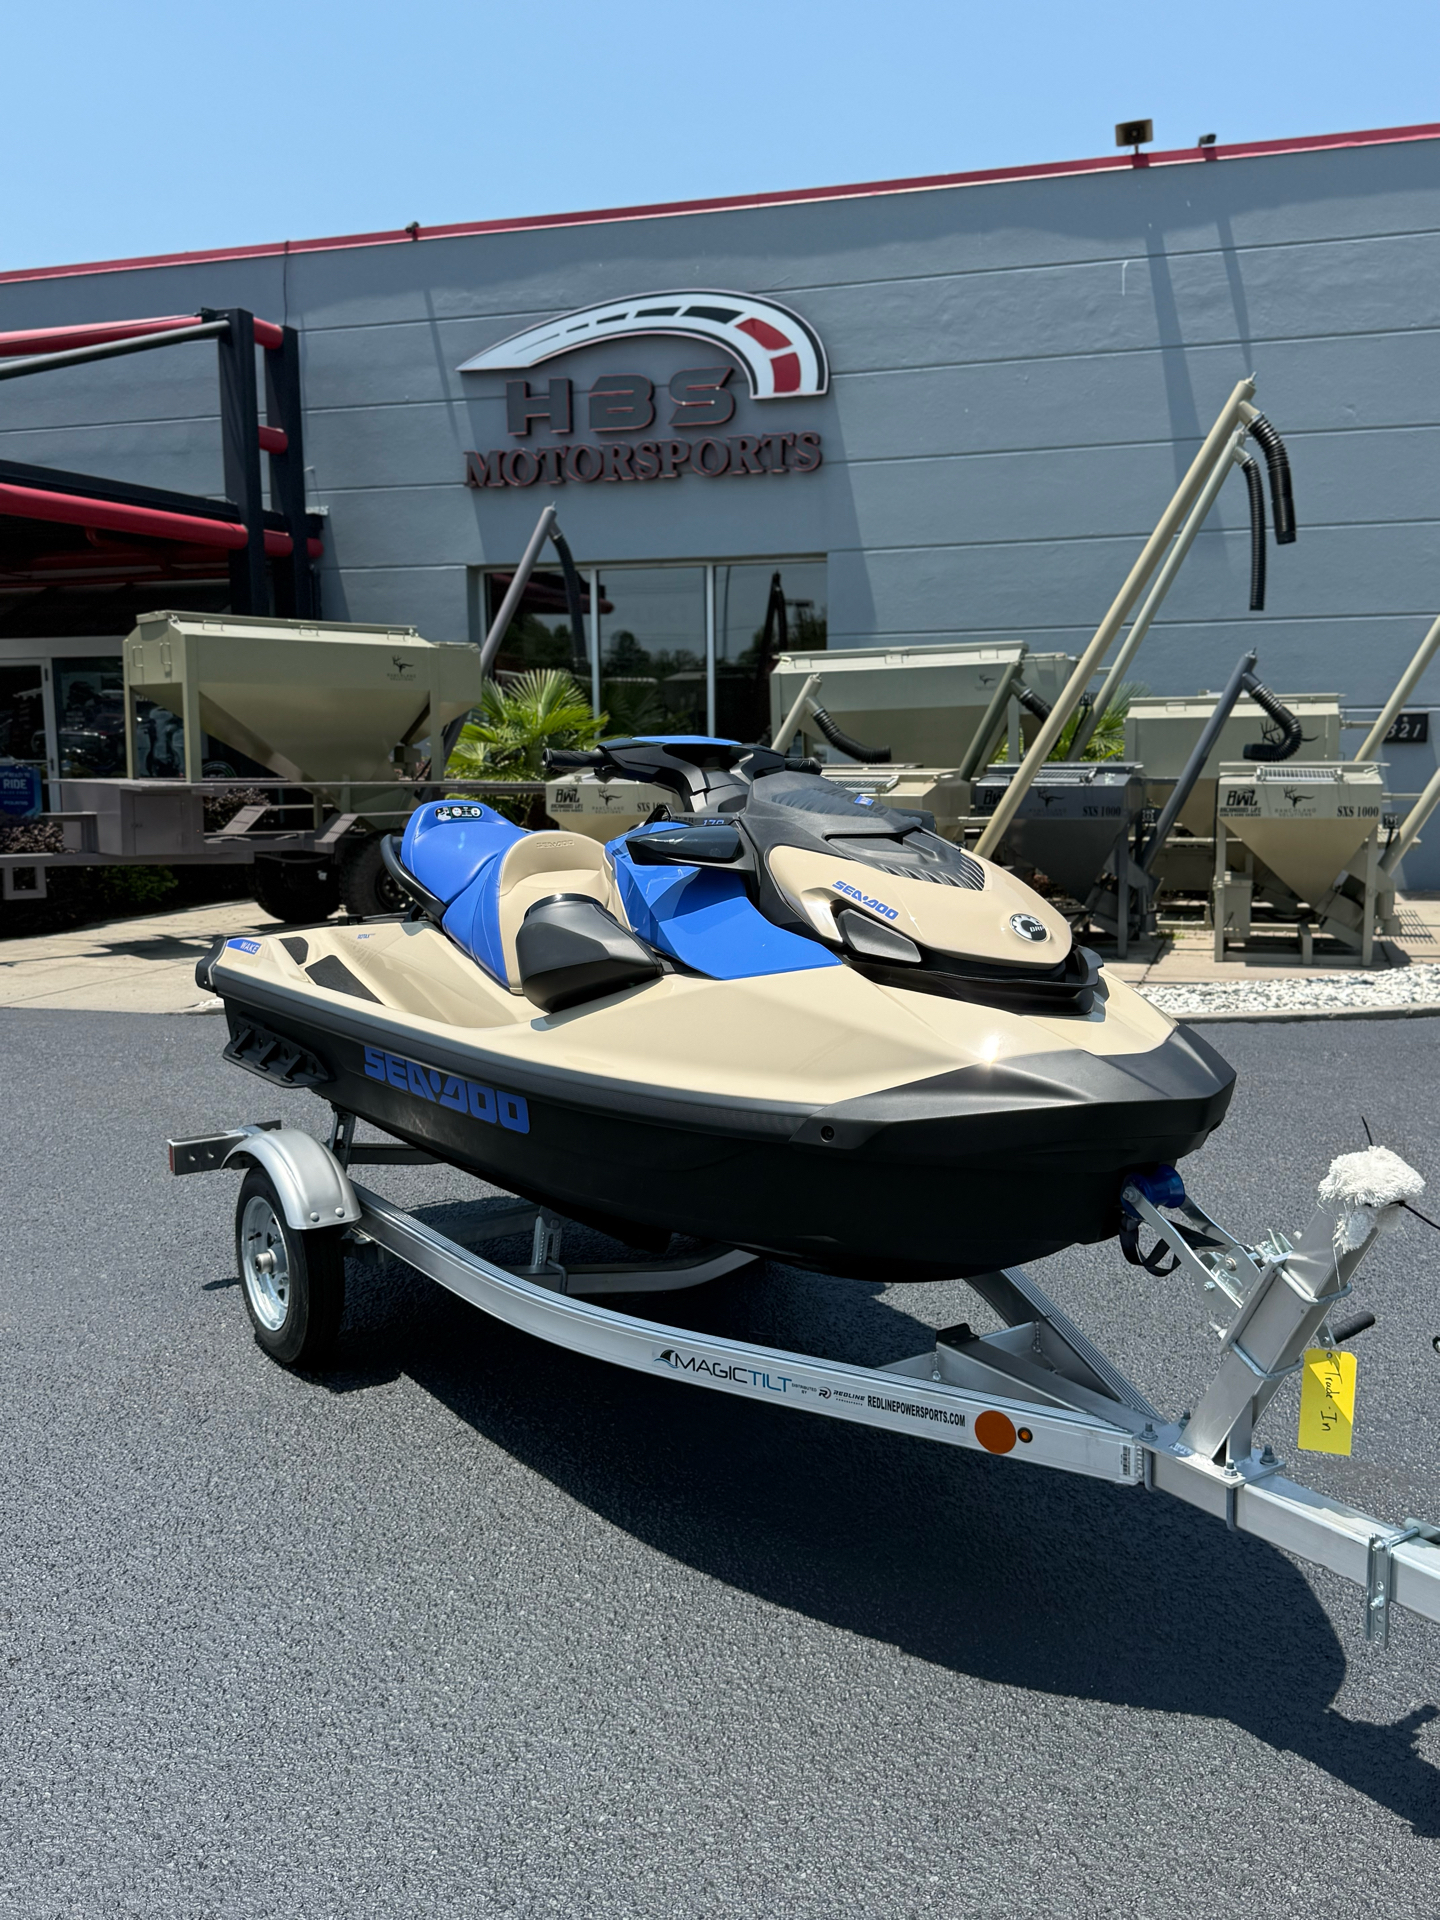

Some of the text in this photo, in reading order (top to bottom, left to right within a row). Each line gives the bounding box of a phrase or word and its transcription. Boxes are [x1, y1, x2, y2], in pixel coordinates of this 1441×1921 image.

[506, 366, 736, 436] HBS
[463, 431, 822, 488] MOTORSPORTS
[3, 779, 28, 790] RIDE
[555, 787, 580, 804] BWL
[1226, 787, 1258, 806] BWL
[1083, 805, 1122, 817] SXS 1000
[1337, 805, 1379, 818] SXS 1000
[240, 941, 260, 953] WAKE
[675, 1352, 792, 1392] MAGICTILT
[833, 1389, 866, 1401] REDLINE
[867, 1395, 966, 1428] REDLINEPOWERSPORTS.COM
